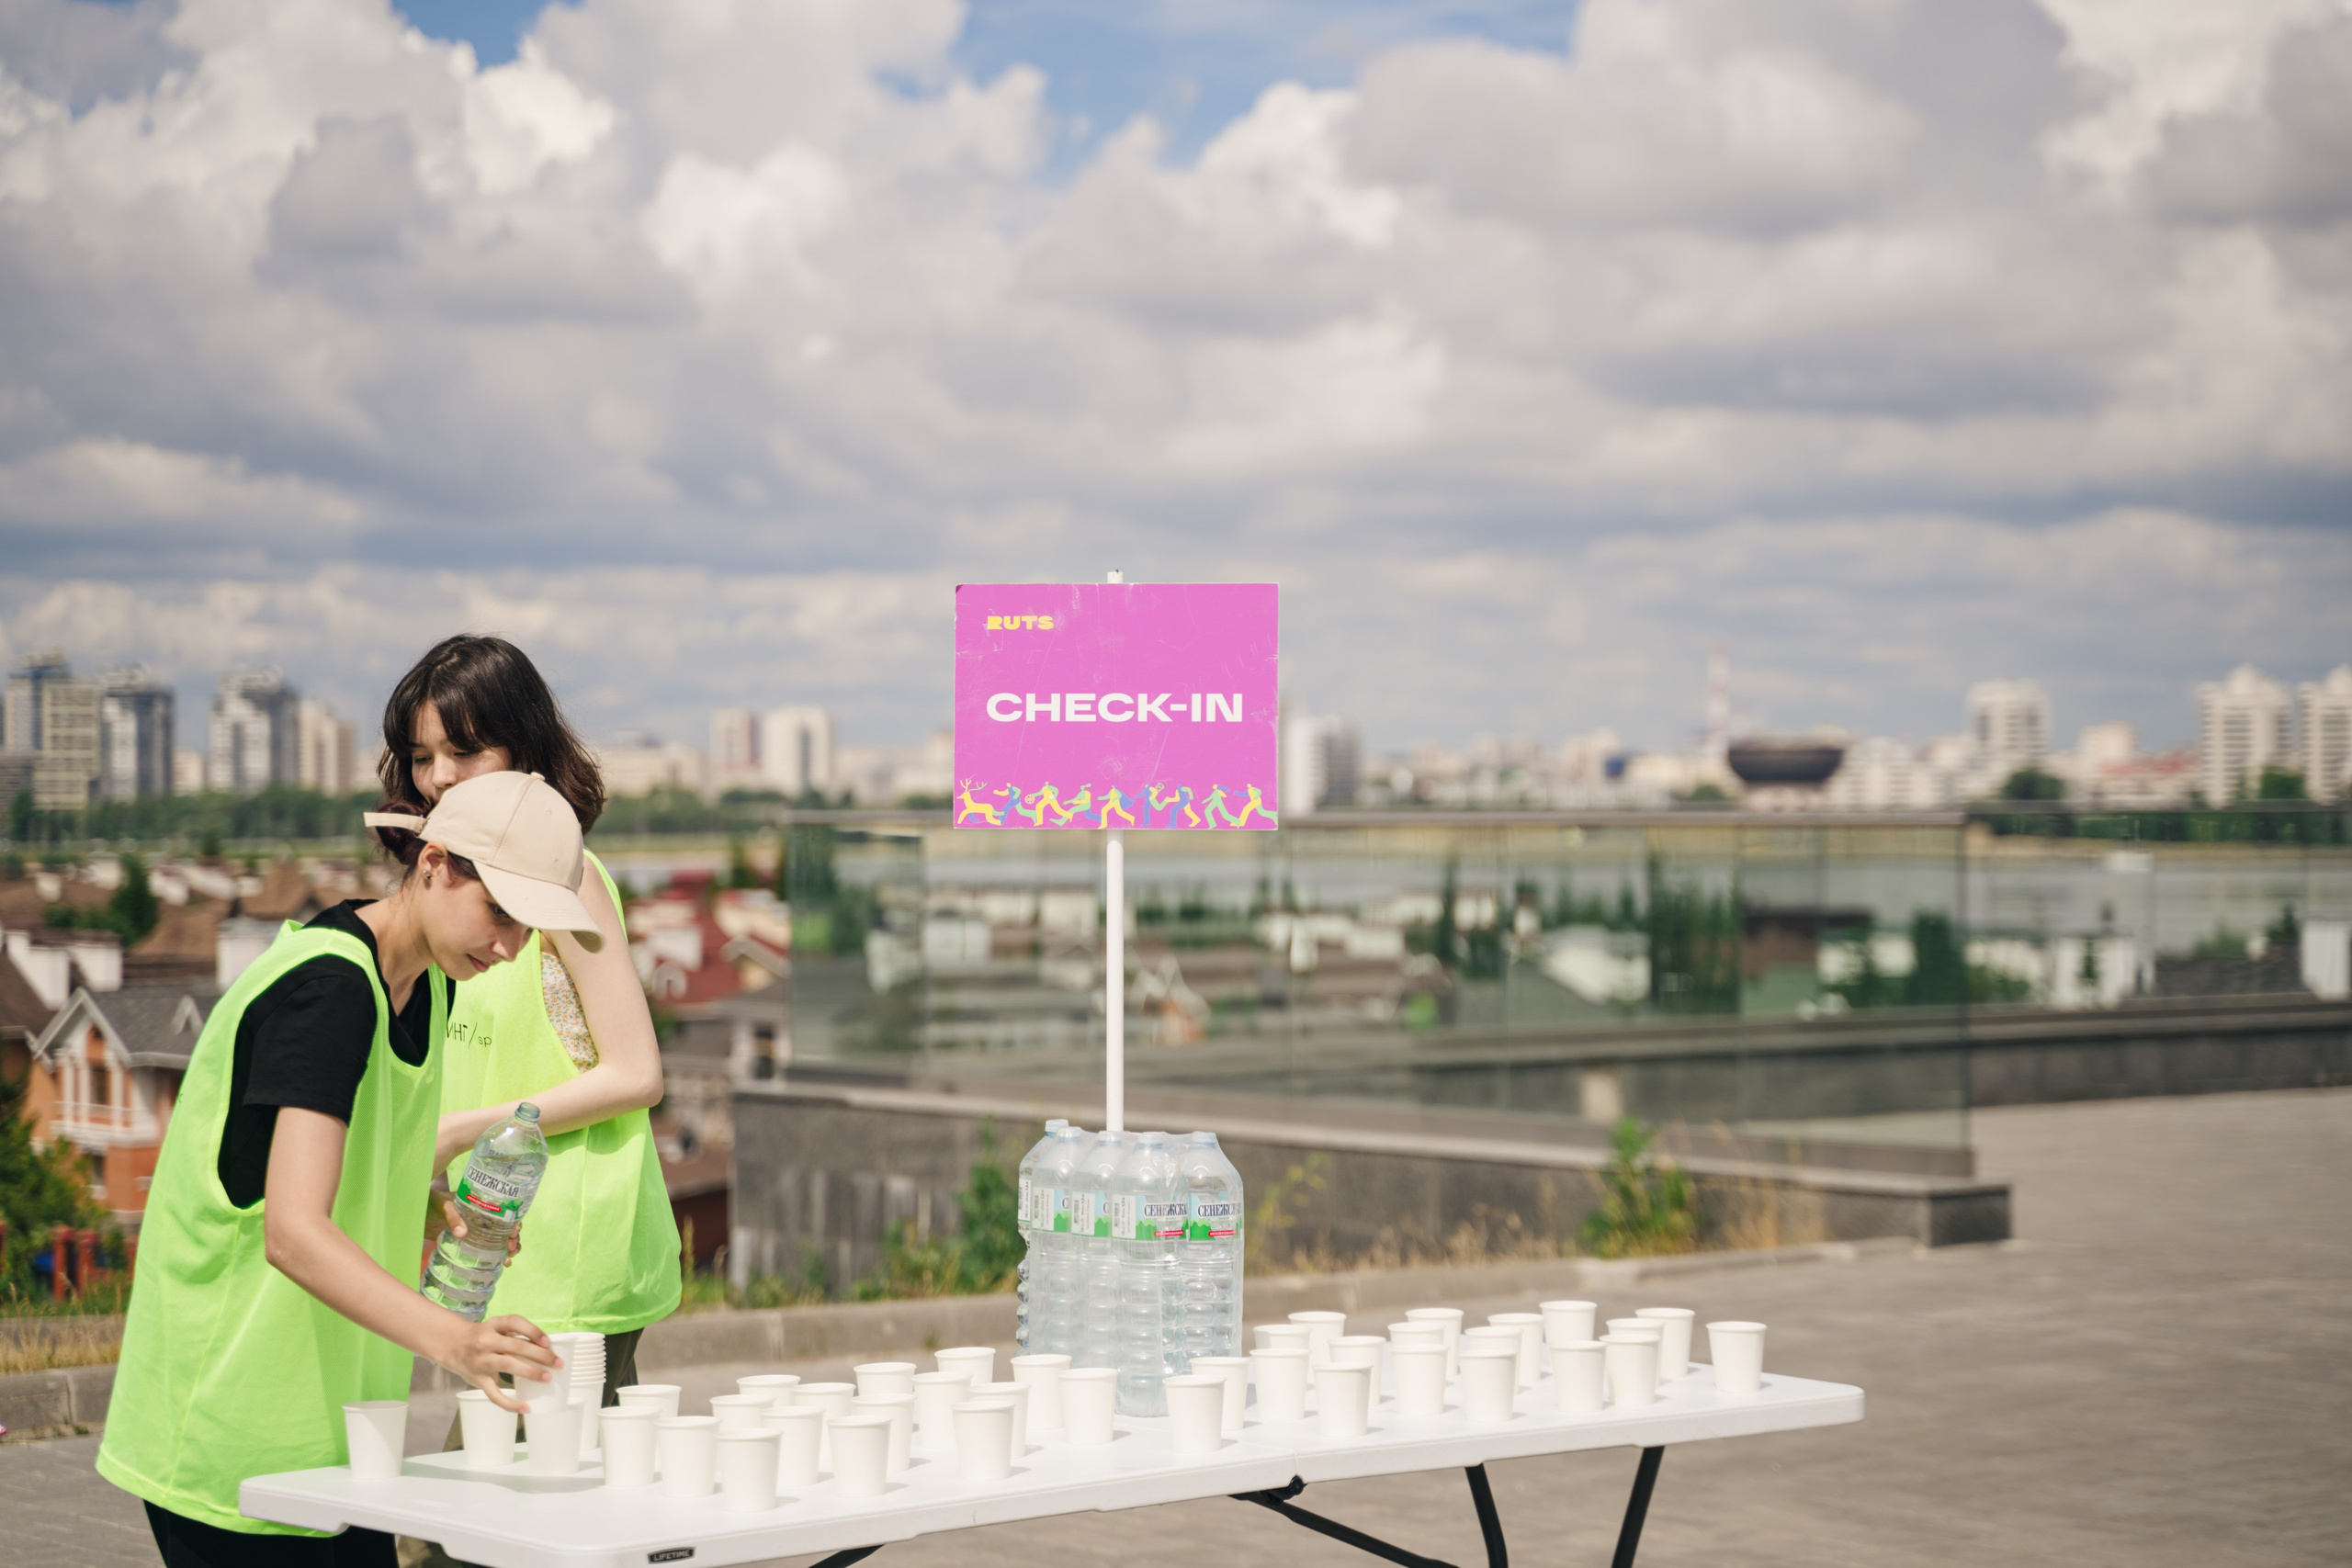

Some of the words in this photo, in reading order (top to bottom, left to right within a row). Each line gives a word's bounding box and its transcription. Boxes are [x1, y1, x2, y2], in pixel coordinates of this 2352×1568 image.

[987, 615, 1055, 630] RUTS
[986, 692, 1243, 723] CHECK-IN
[467, 1165, 520, 1198] СЕНЕЖСКАЯ
[1144, 1202, 1188, 1217] СЕНЕЖСКА
[653, 1550, 691, 1562] LIFETIME
